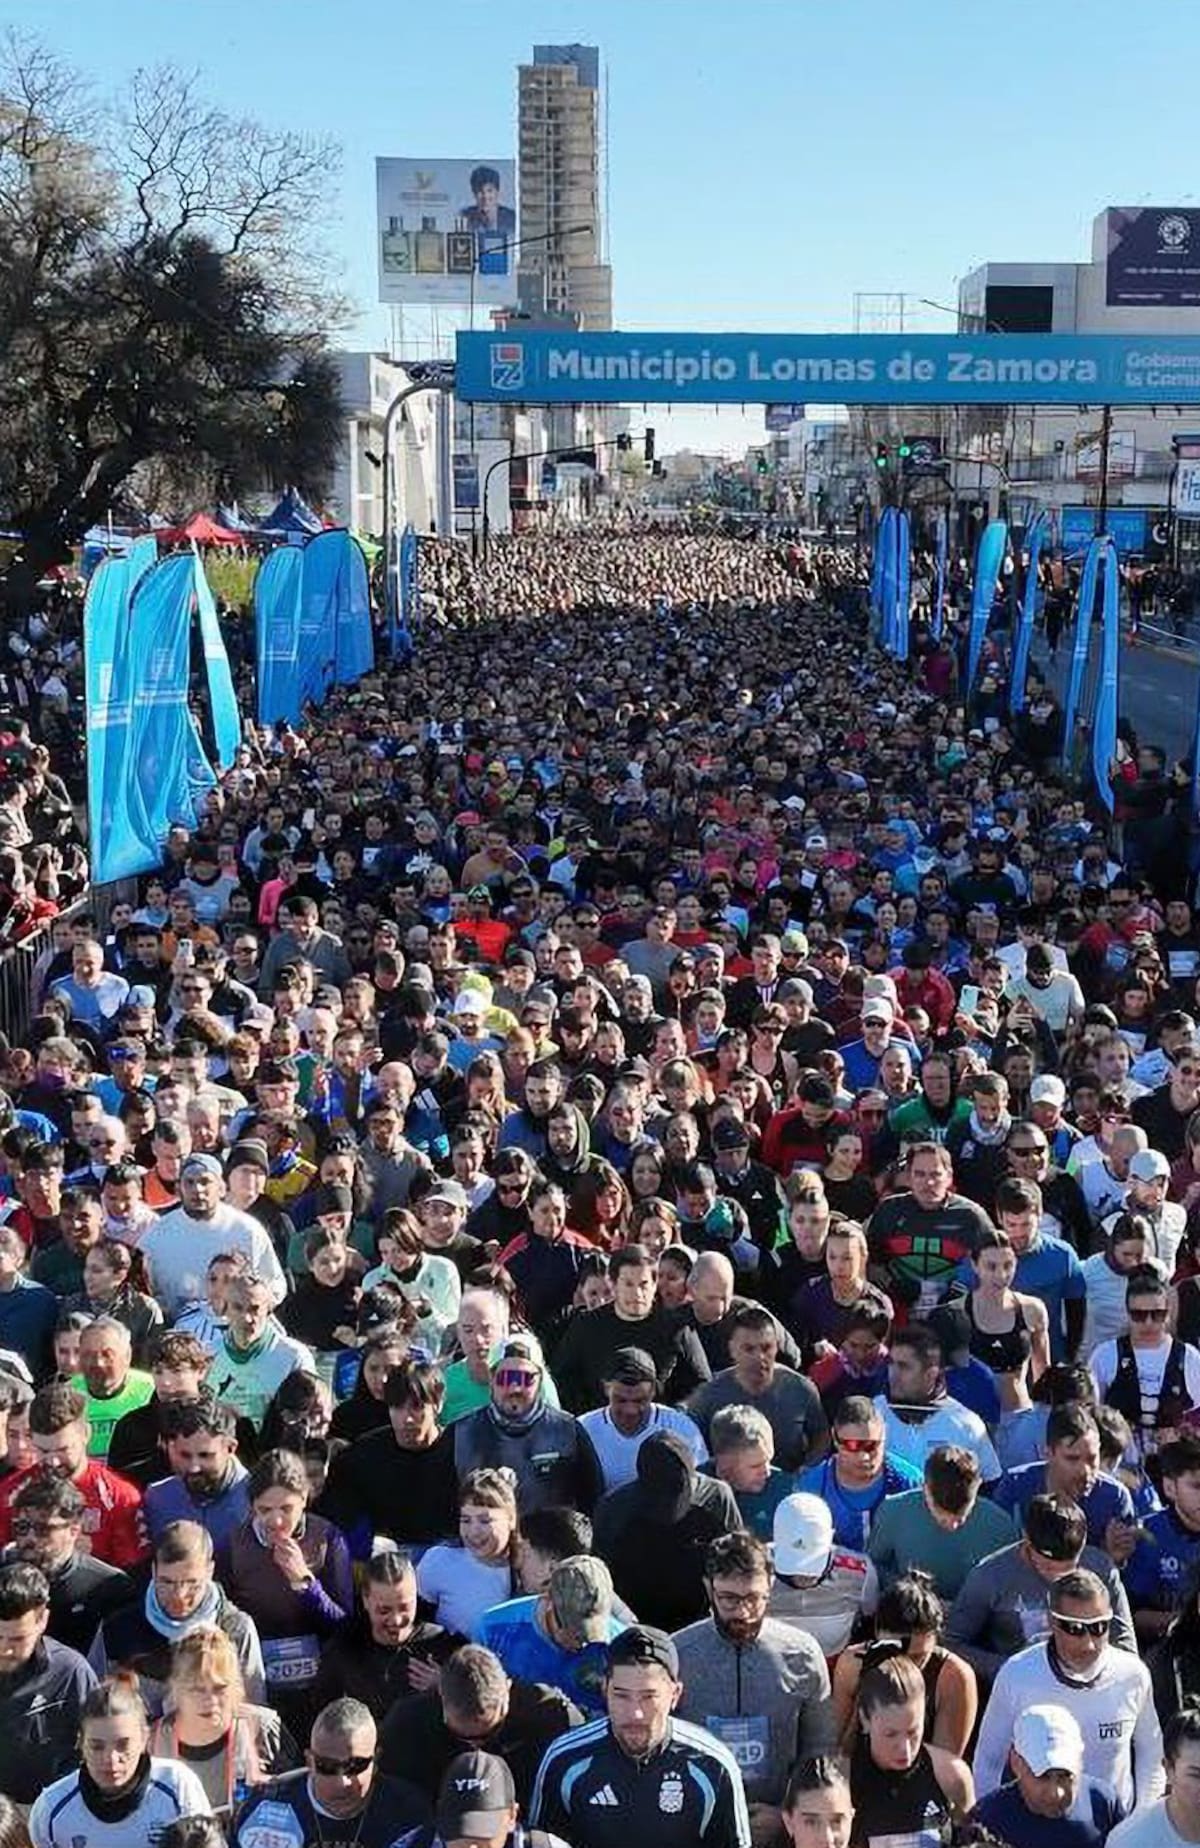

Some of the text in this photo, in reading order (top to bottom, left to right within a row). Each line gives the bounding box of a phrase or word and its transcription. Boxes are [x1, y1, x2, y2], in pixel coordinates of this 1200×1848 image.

[548, 349, 1097, 387] Municipio Lomas de Zamora
